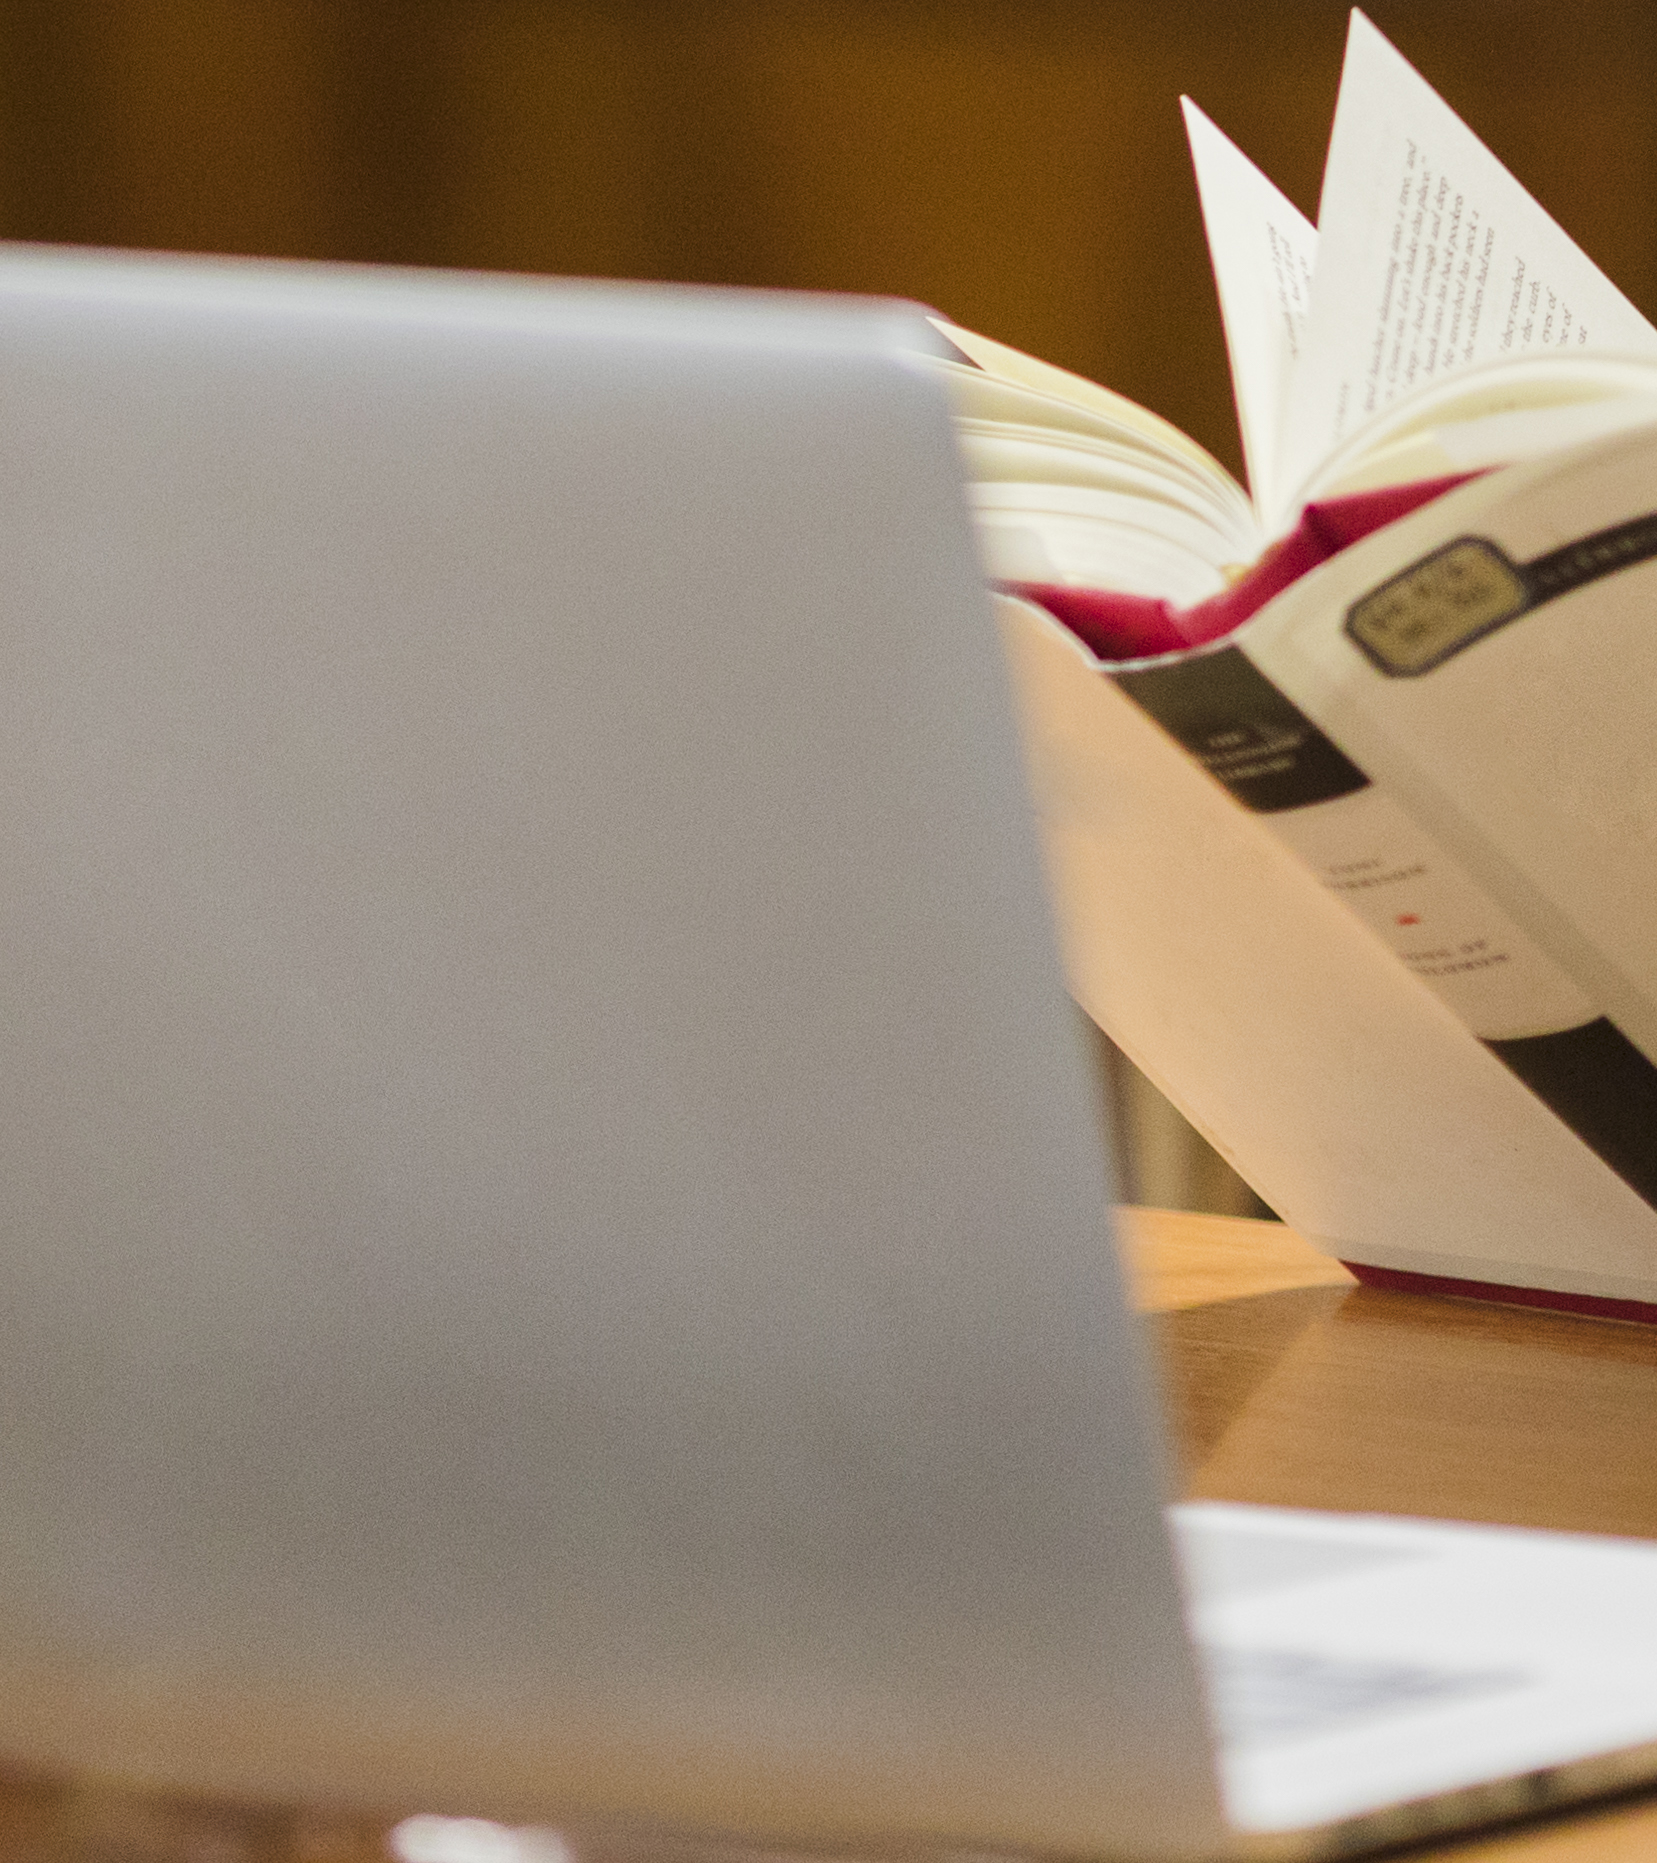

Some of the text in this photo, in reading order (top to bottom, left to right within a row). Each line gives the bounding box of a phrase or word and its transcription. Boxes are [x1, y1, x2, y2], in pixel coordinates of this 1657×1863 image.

[1369, 328, 1385, 378] hatchet
[1380, 257, 1400, 323] slamming
[1392, 223, 1403, 253] into
[1406, 139, 1417, 170] and
[1475, 255, 1489, 286] had
[1484, 227, 1494, 258] seen
[1389, 340, 1402, 383] Come
[1398, 278, 1412, 312] Let's
[1406, 238, 1418, 275] shake
[1414, 211, 1423, 235] this
[1405, 176, 1450, 384] deep loud enough and deep
[1424, 194, 1463, 375] hands into his back pockets
[1450, 279, 1466, 344] stretched
[1458, 260, 1470, 280] his
[1466, 222, 1477, 256] neck
[1469, 286, 1484, 338] soldiers
[1502, 256, 1526, 347] they reached
[1542, 286, 1557, 343] eyes of
[1562, 303, 1572, 327] of
[1521, 318, 1533, 342] the
